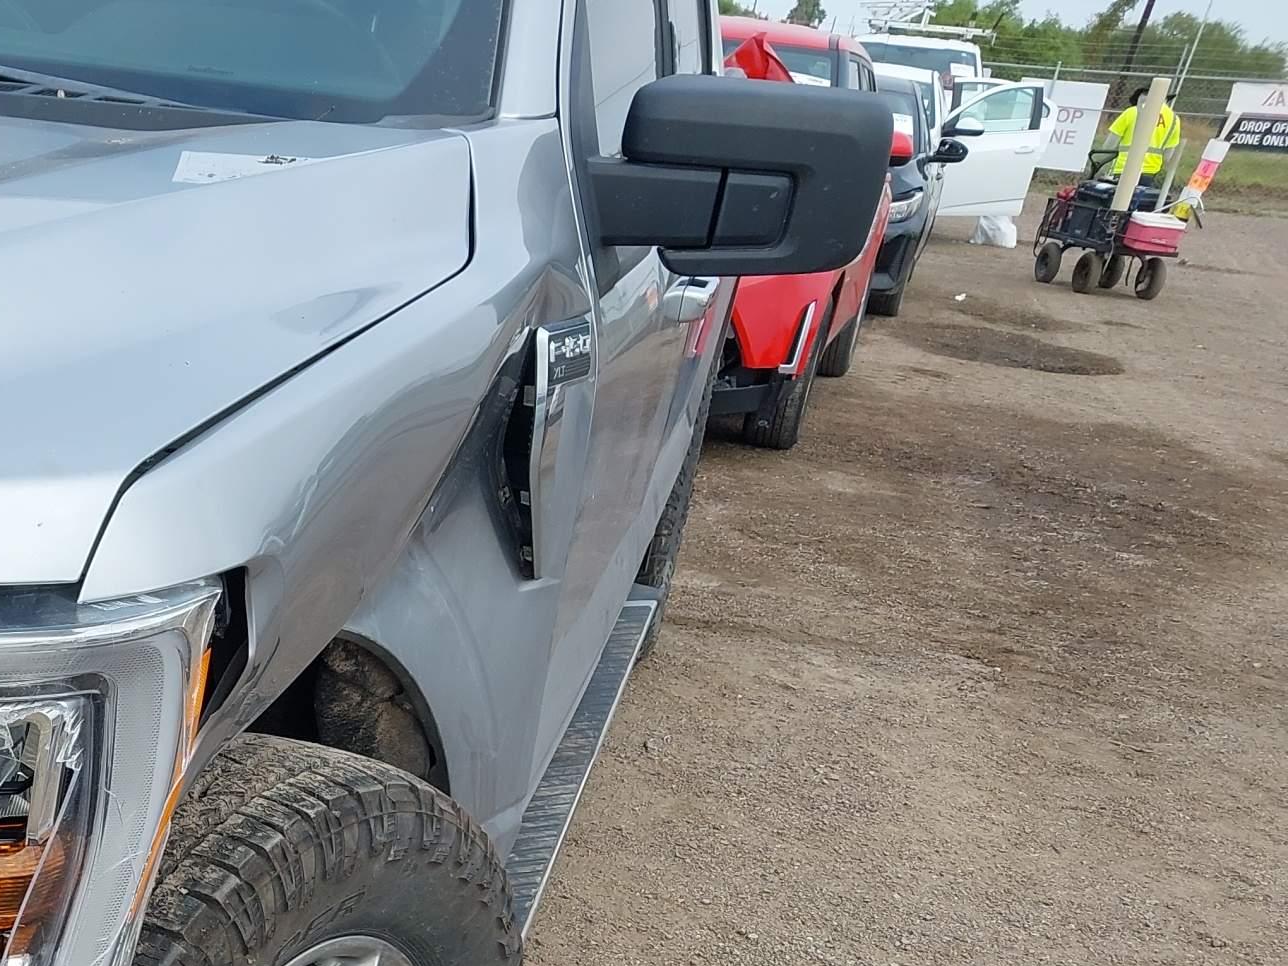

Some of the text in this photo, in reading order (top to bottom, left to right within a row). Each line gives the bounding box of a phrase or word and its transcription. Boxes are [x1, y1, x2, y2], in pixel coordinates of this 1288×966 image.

[1056, 109, 1084, 123] OP
[1239, 120, 1271, 133] DROP
[1049, 129, 1077, 144] NE
[1229, 133, 1263, 145] ZONE
